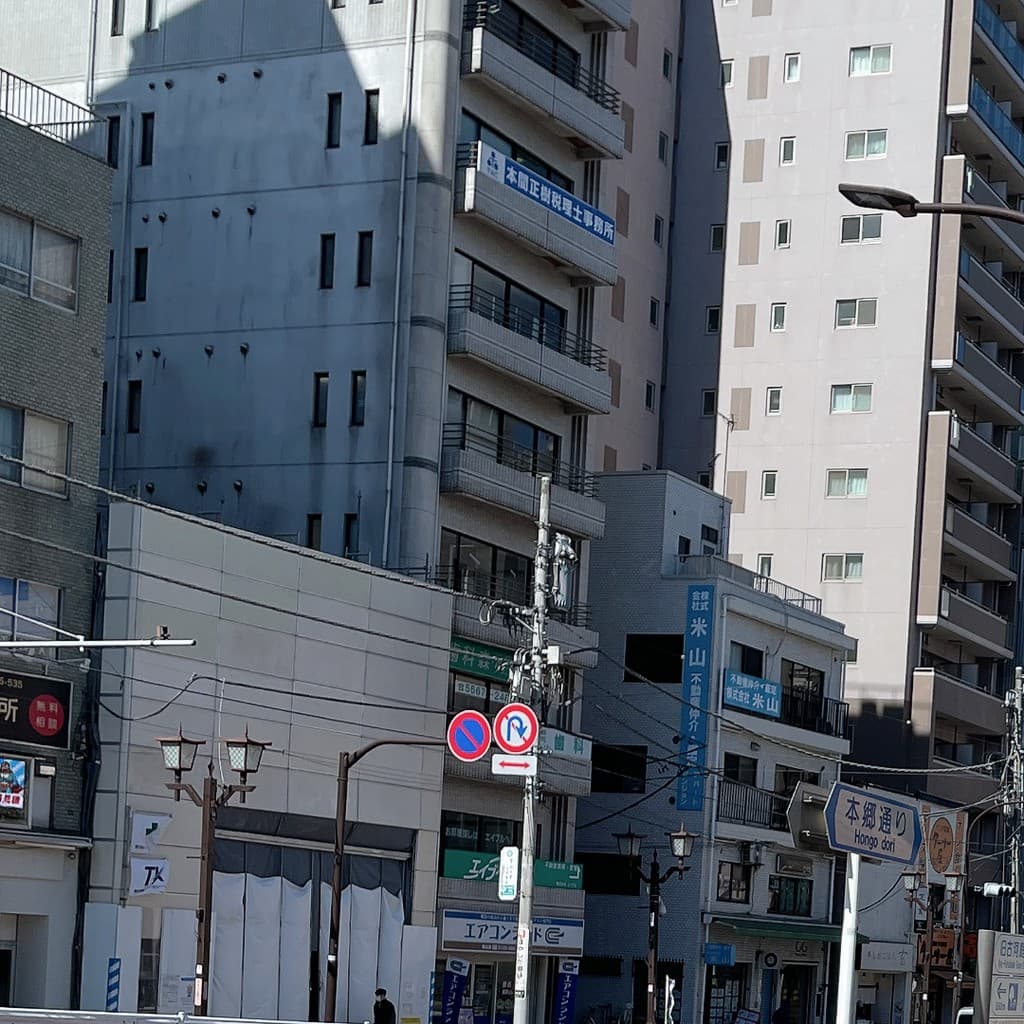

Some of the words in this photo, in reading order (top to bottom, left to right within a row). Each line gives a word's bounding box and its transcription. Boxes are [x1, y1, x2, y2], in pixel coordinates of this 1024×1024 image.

[689, 617, 708, 667] 米山
[752, 692, 779, 713] 米山
[845, 796, 907, 837] 本郷通り
[854, 828, 878, 850] Hongo
[881, 836, 896, 853] dori
[463, 857, 500, 880] エイブ
